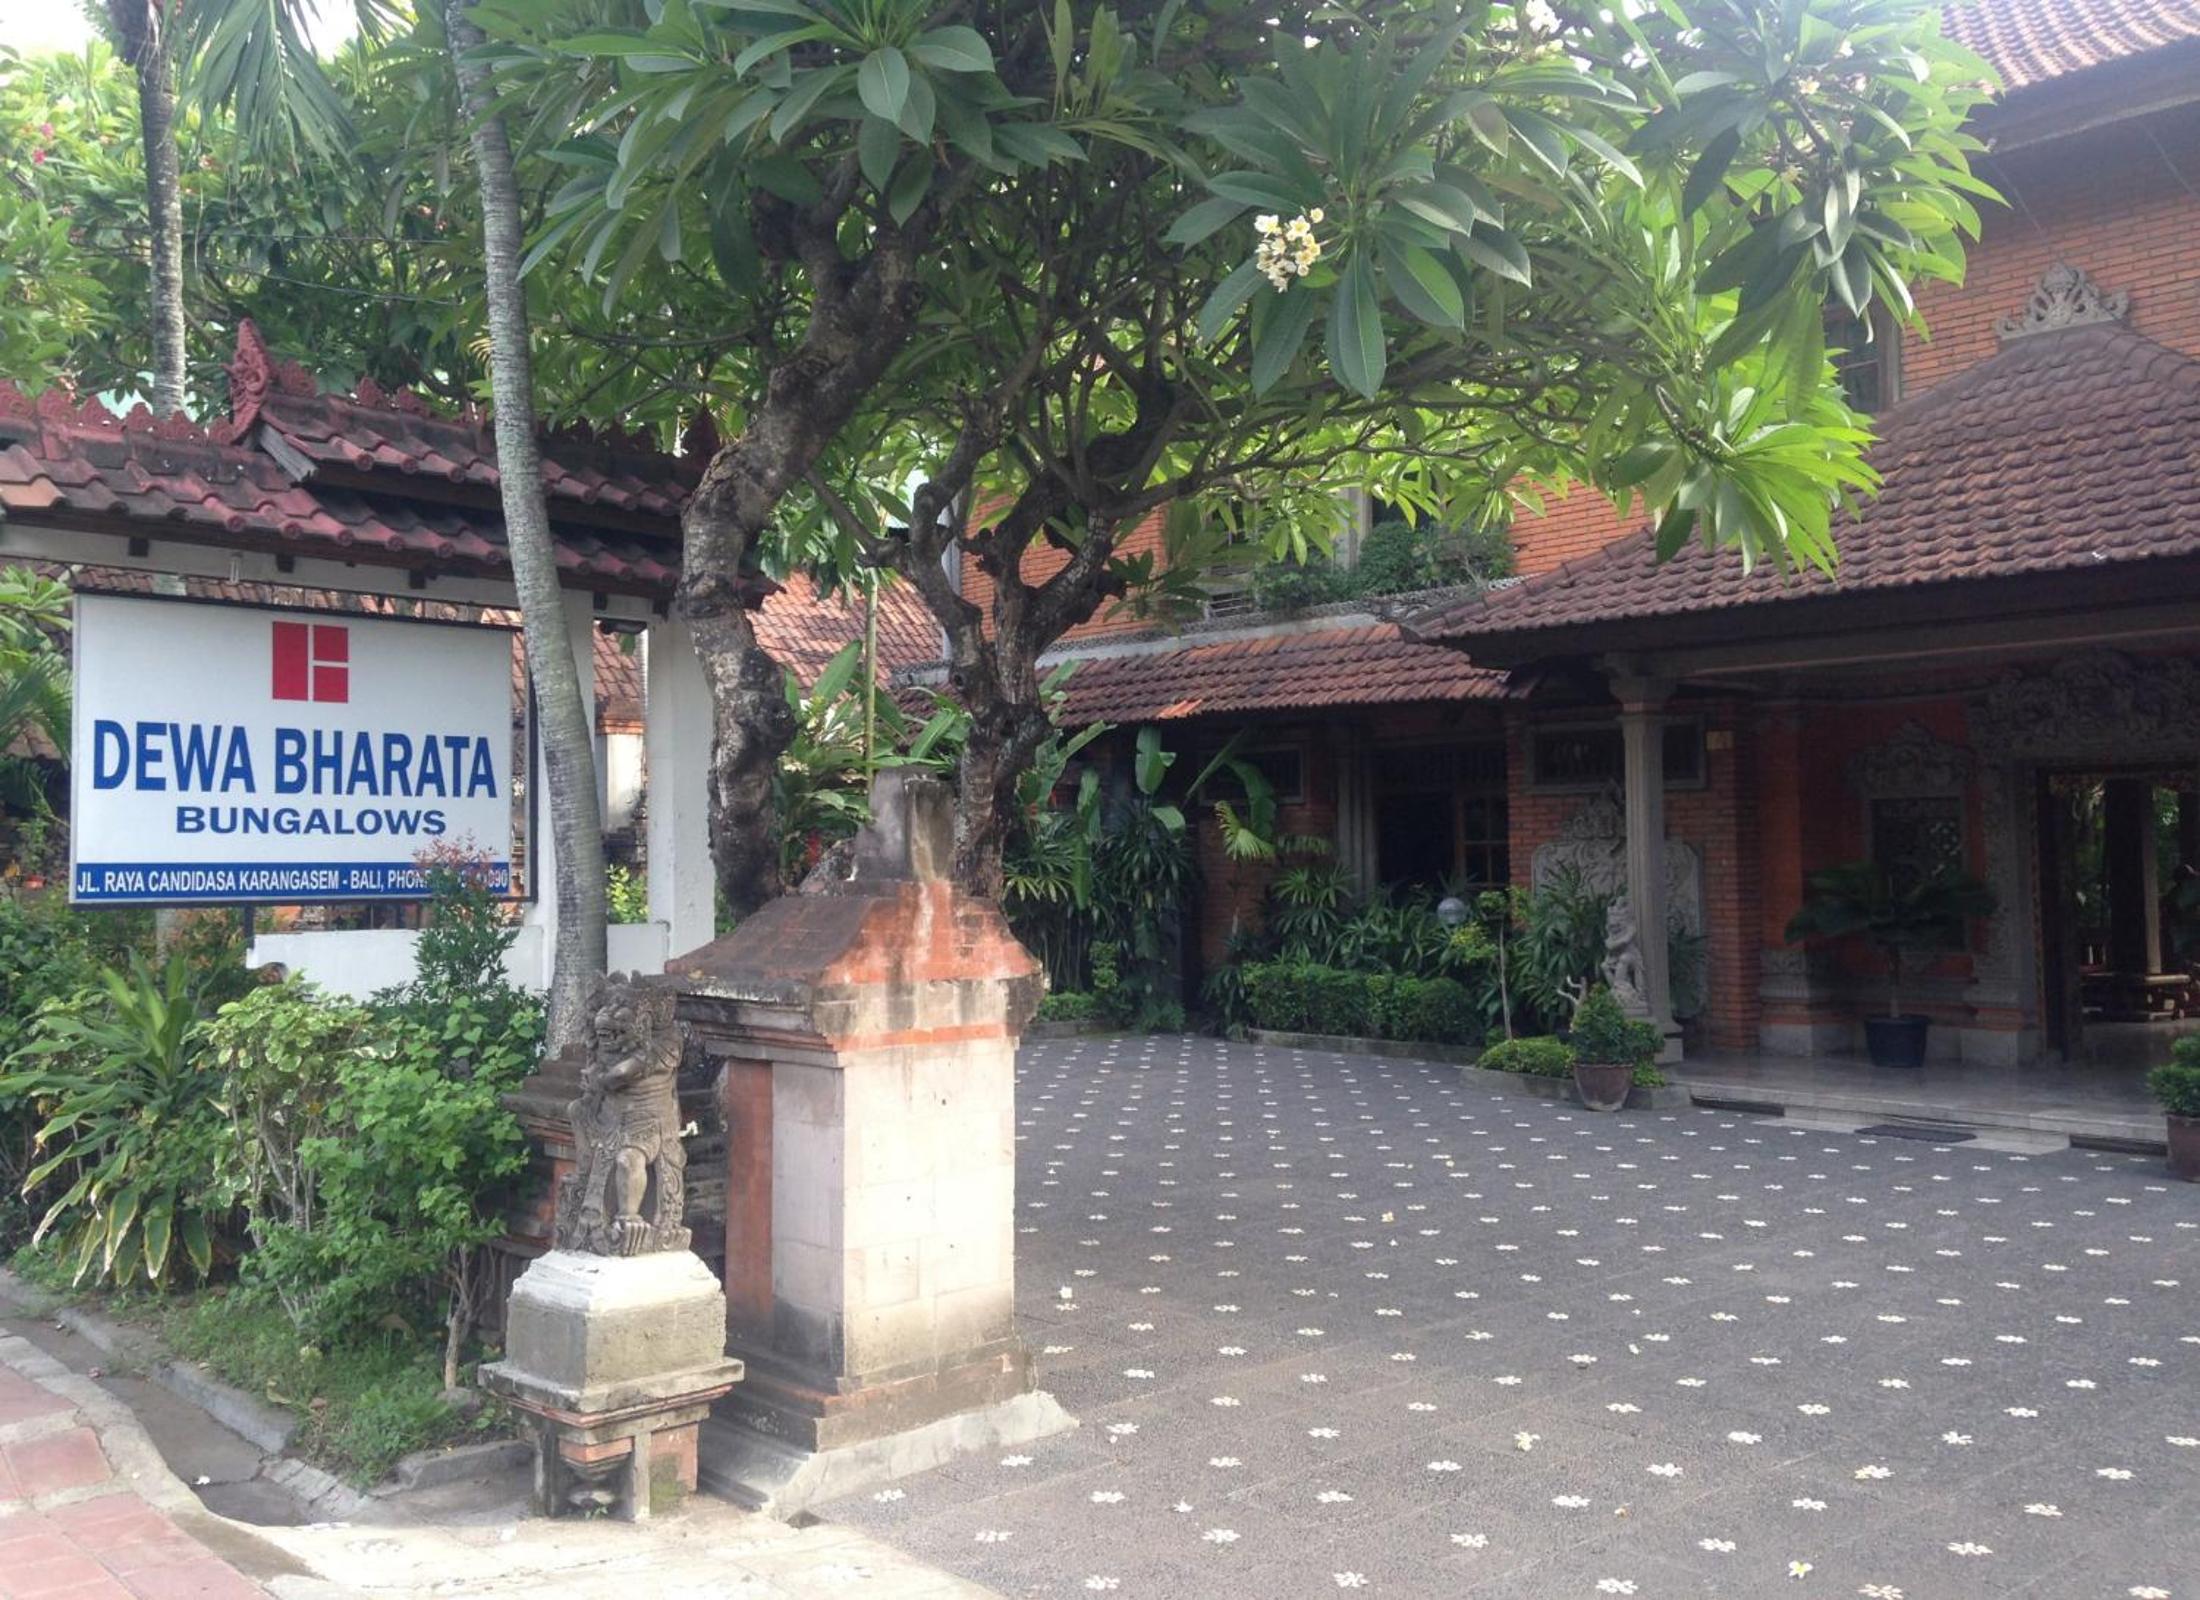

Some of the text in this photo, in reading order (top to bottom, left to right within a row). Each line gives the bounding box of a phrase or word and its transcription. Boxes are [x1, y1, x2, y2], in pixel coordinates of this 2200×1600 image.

[93, 719, 497, 798] DEWA BHARATA
[176, 806, 447, 836] BUNGALOWS
[77, 871, 100, 893] JL.
[104, 871, 145, 892] RAYA
[148, 870, 235, 892] CANDIDASA
[239, 870, 339, 891] KARANGASEM
[350, 870, 384, 892] BALI,
